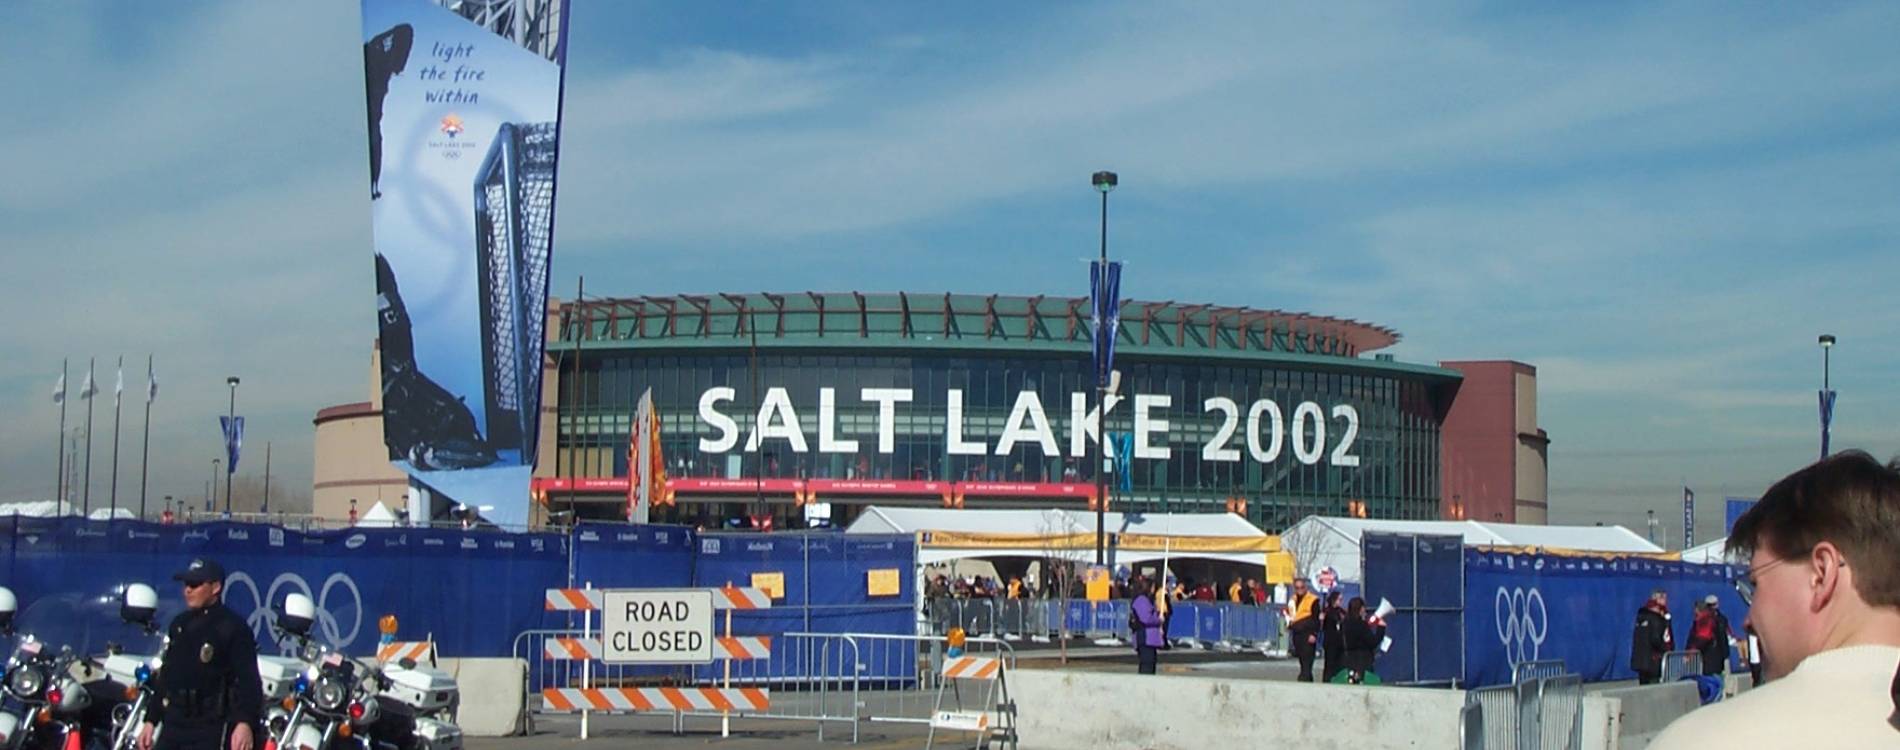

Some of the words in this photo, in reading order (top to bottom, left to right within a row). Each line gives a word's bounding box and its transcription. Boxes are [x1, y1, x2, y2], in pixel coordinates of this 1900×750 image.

[432, 41, 474, 62] light
[420, 65, 446, 80] the
[454, 64, 485, 83] fire
[425, 88, 478, 104] within
[698, 387, 912, 453] SALT
[946, 389, 1172, 460] LAKE
[1201, 397, 1360, 466] 2002
[625, 601, 689, 622] ROAD
[612, 631, 702, 652] CLOSED
